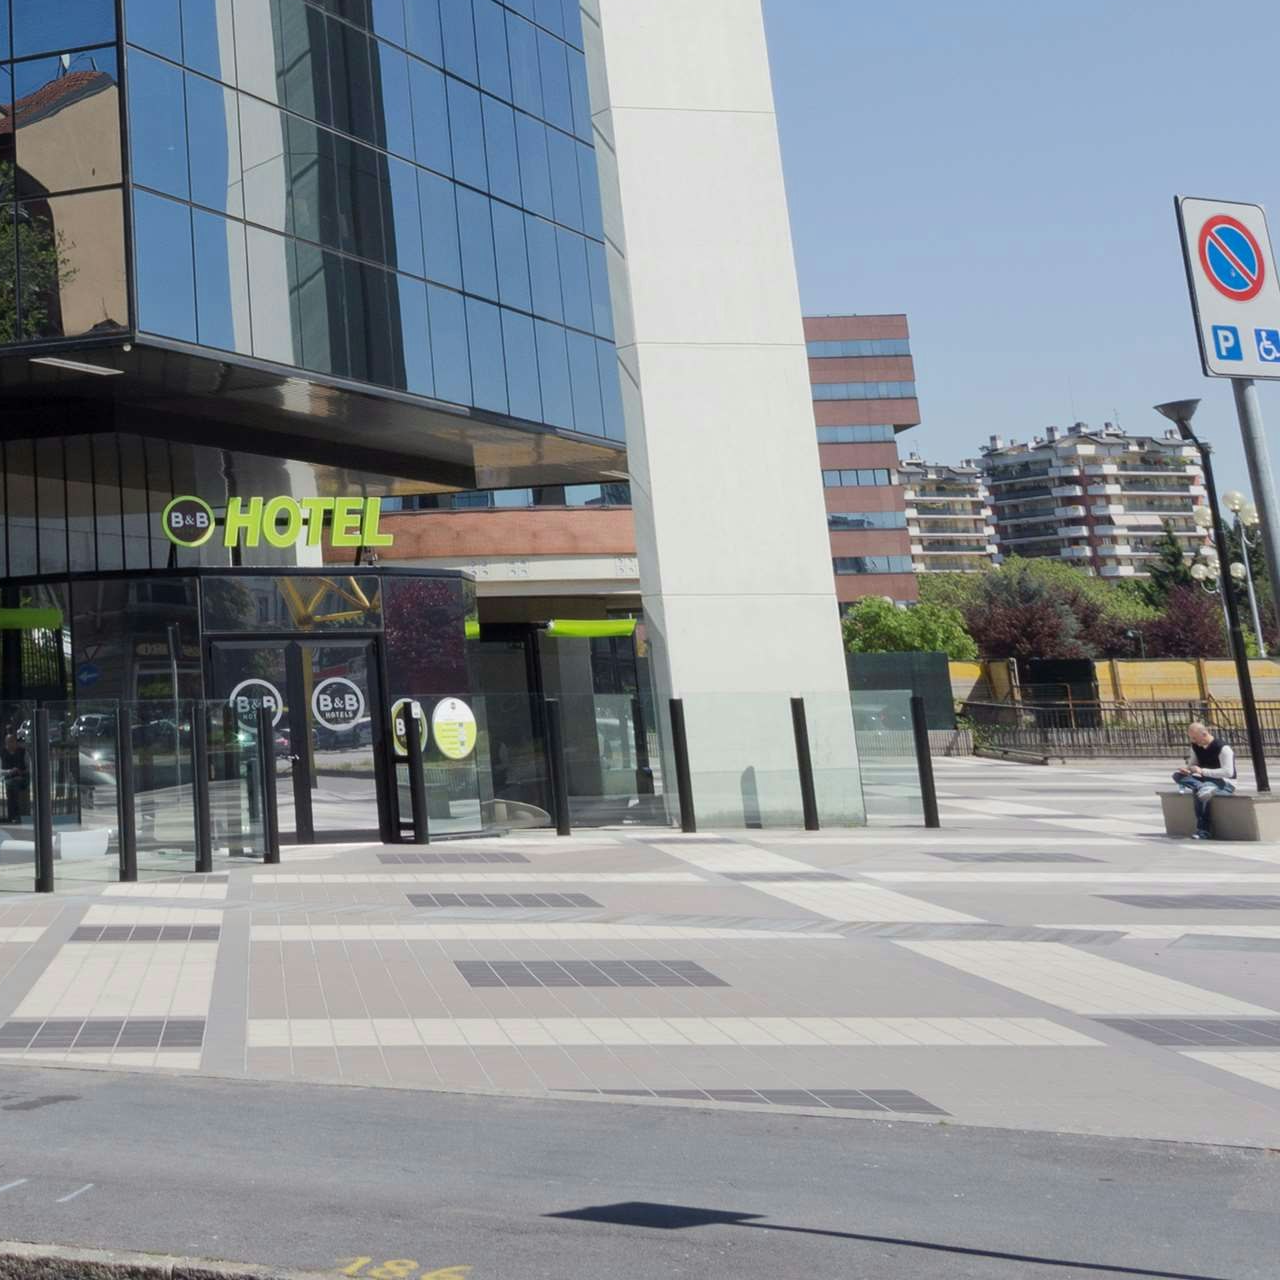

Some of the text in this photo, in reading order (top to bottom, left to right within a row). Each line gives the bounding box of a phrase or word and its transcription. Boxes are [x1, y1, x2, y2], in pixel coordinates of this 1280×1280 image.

[1217, 329, 1235, 356] P
[171, 496, 394, 548] B&B HOTEL
[320, 694, 358, 711] B&B
[325, 711, 353, 719] HOTELS
